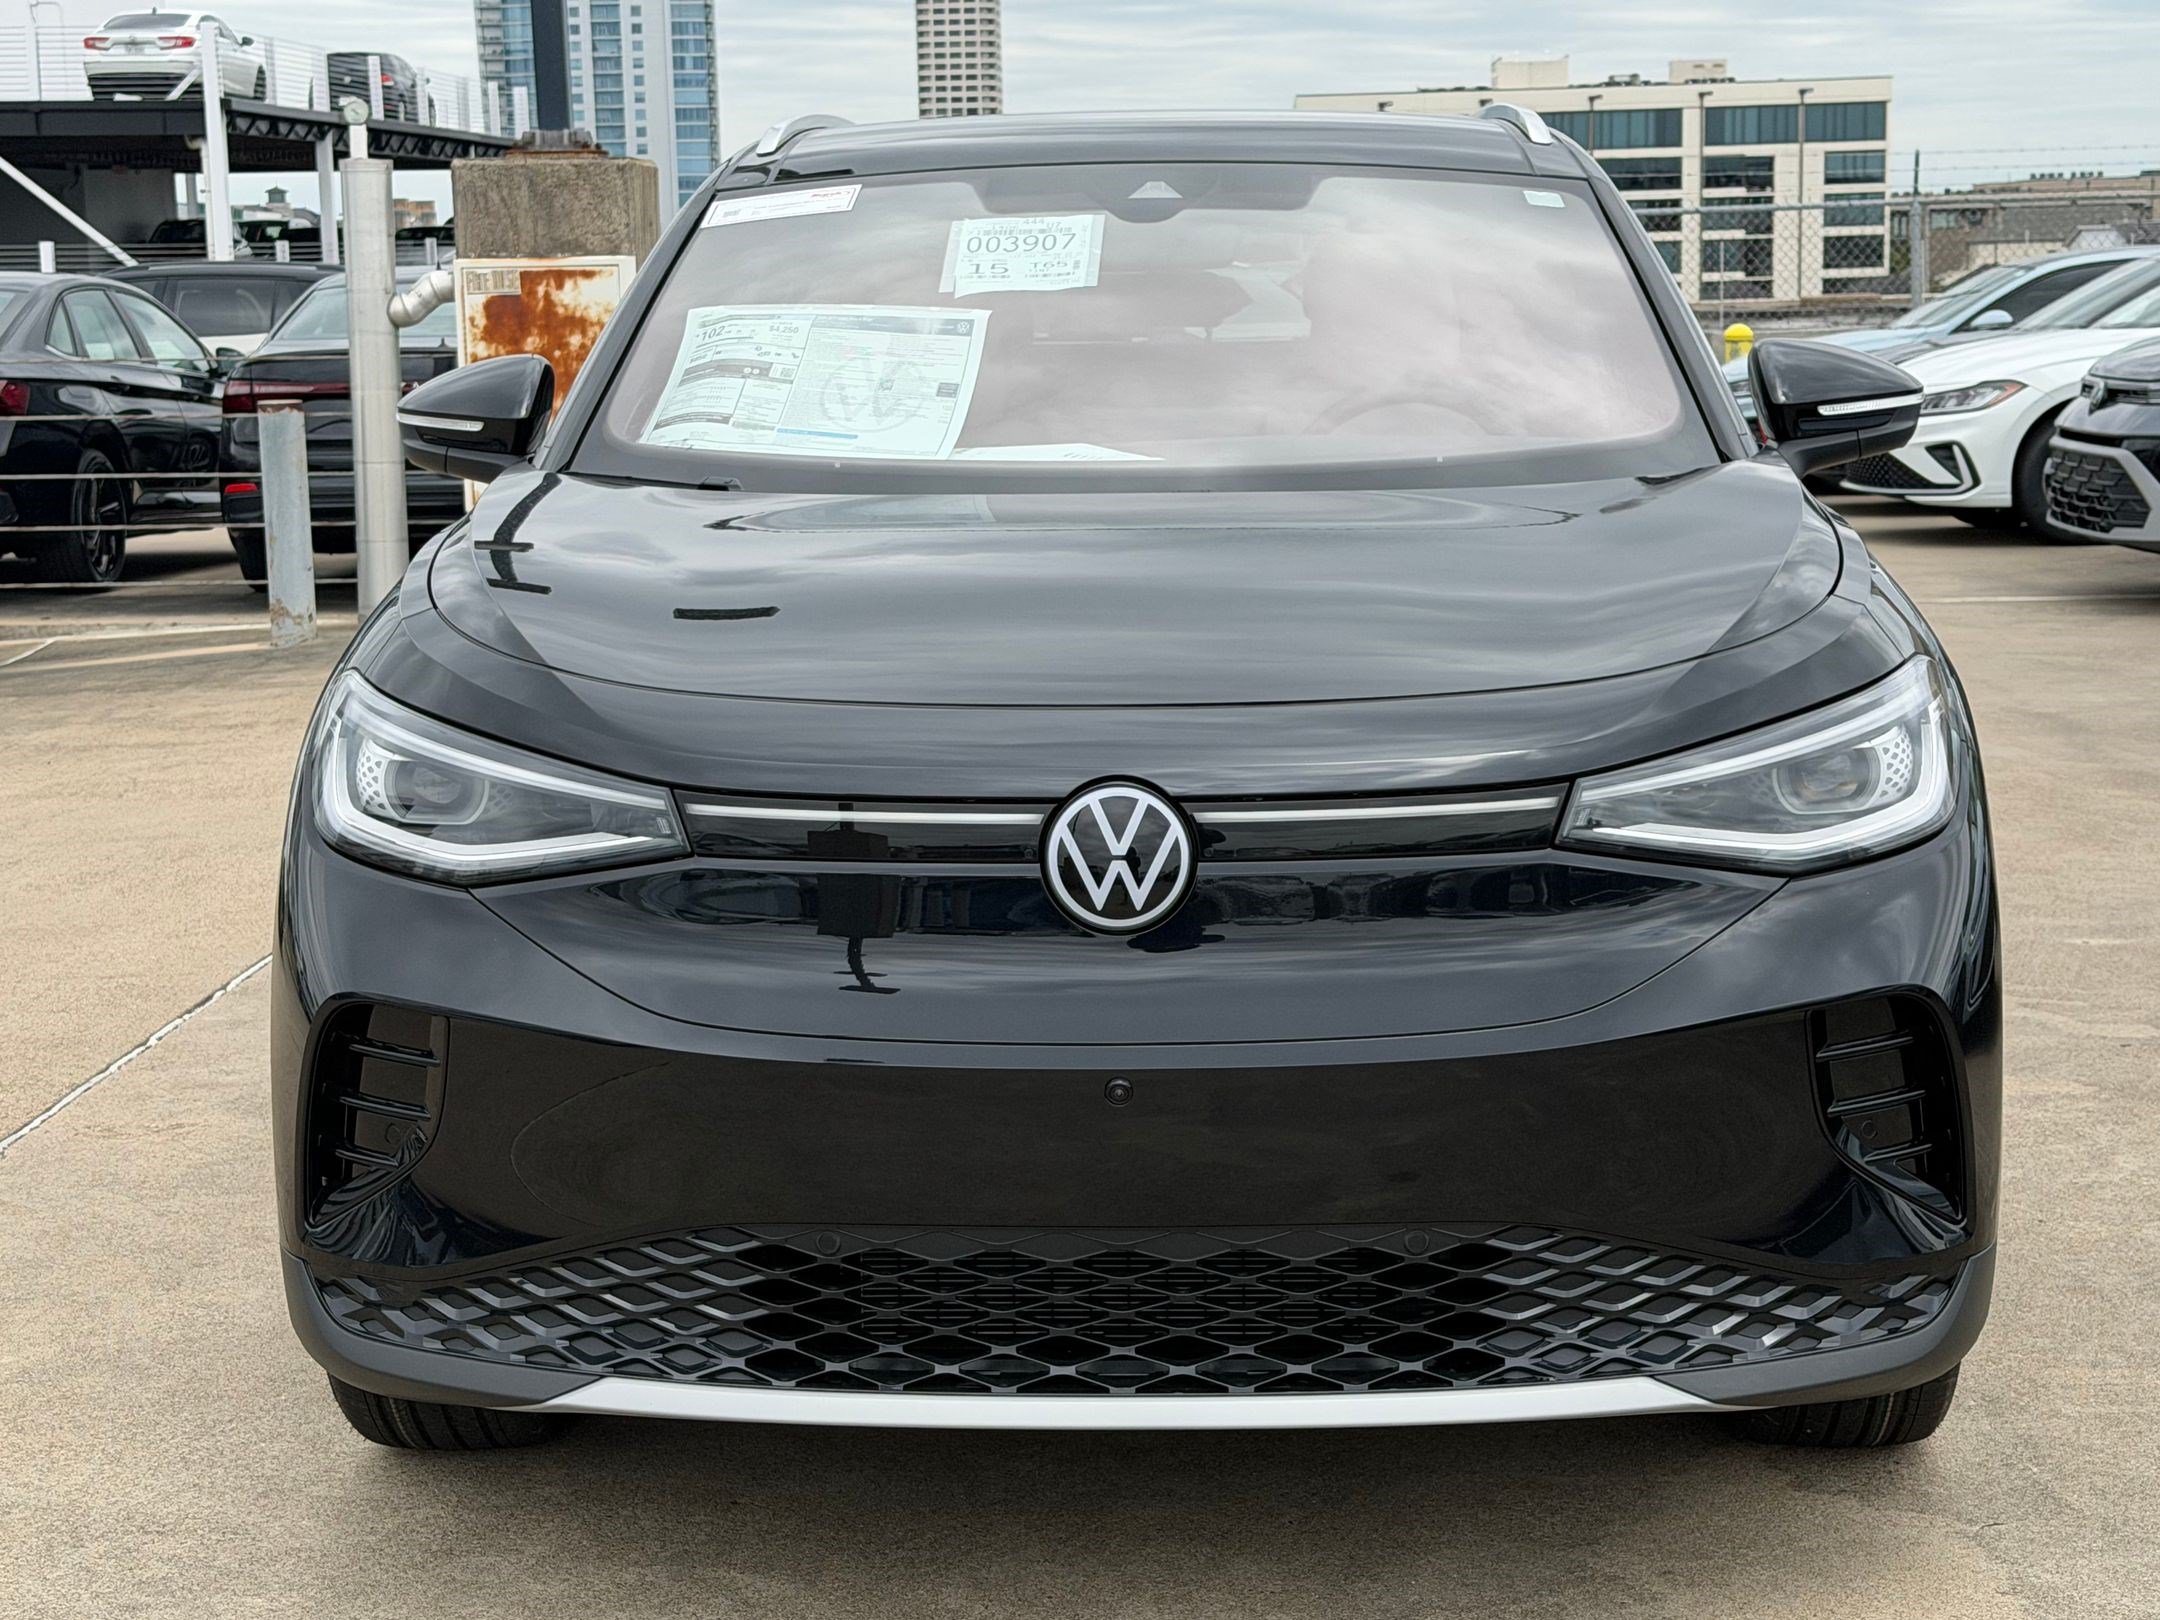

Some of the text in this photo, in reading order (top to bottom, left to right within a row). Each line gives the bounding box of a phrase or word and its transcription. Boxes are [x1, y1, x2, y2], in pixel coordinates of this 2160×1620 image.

[966, 232, 1077, 254] 003907
[967, 262, 1010, 275] 15
[701, 326, 726, 341] 102
[1048, 786, 1190, 928] VW
